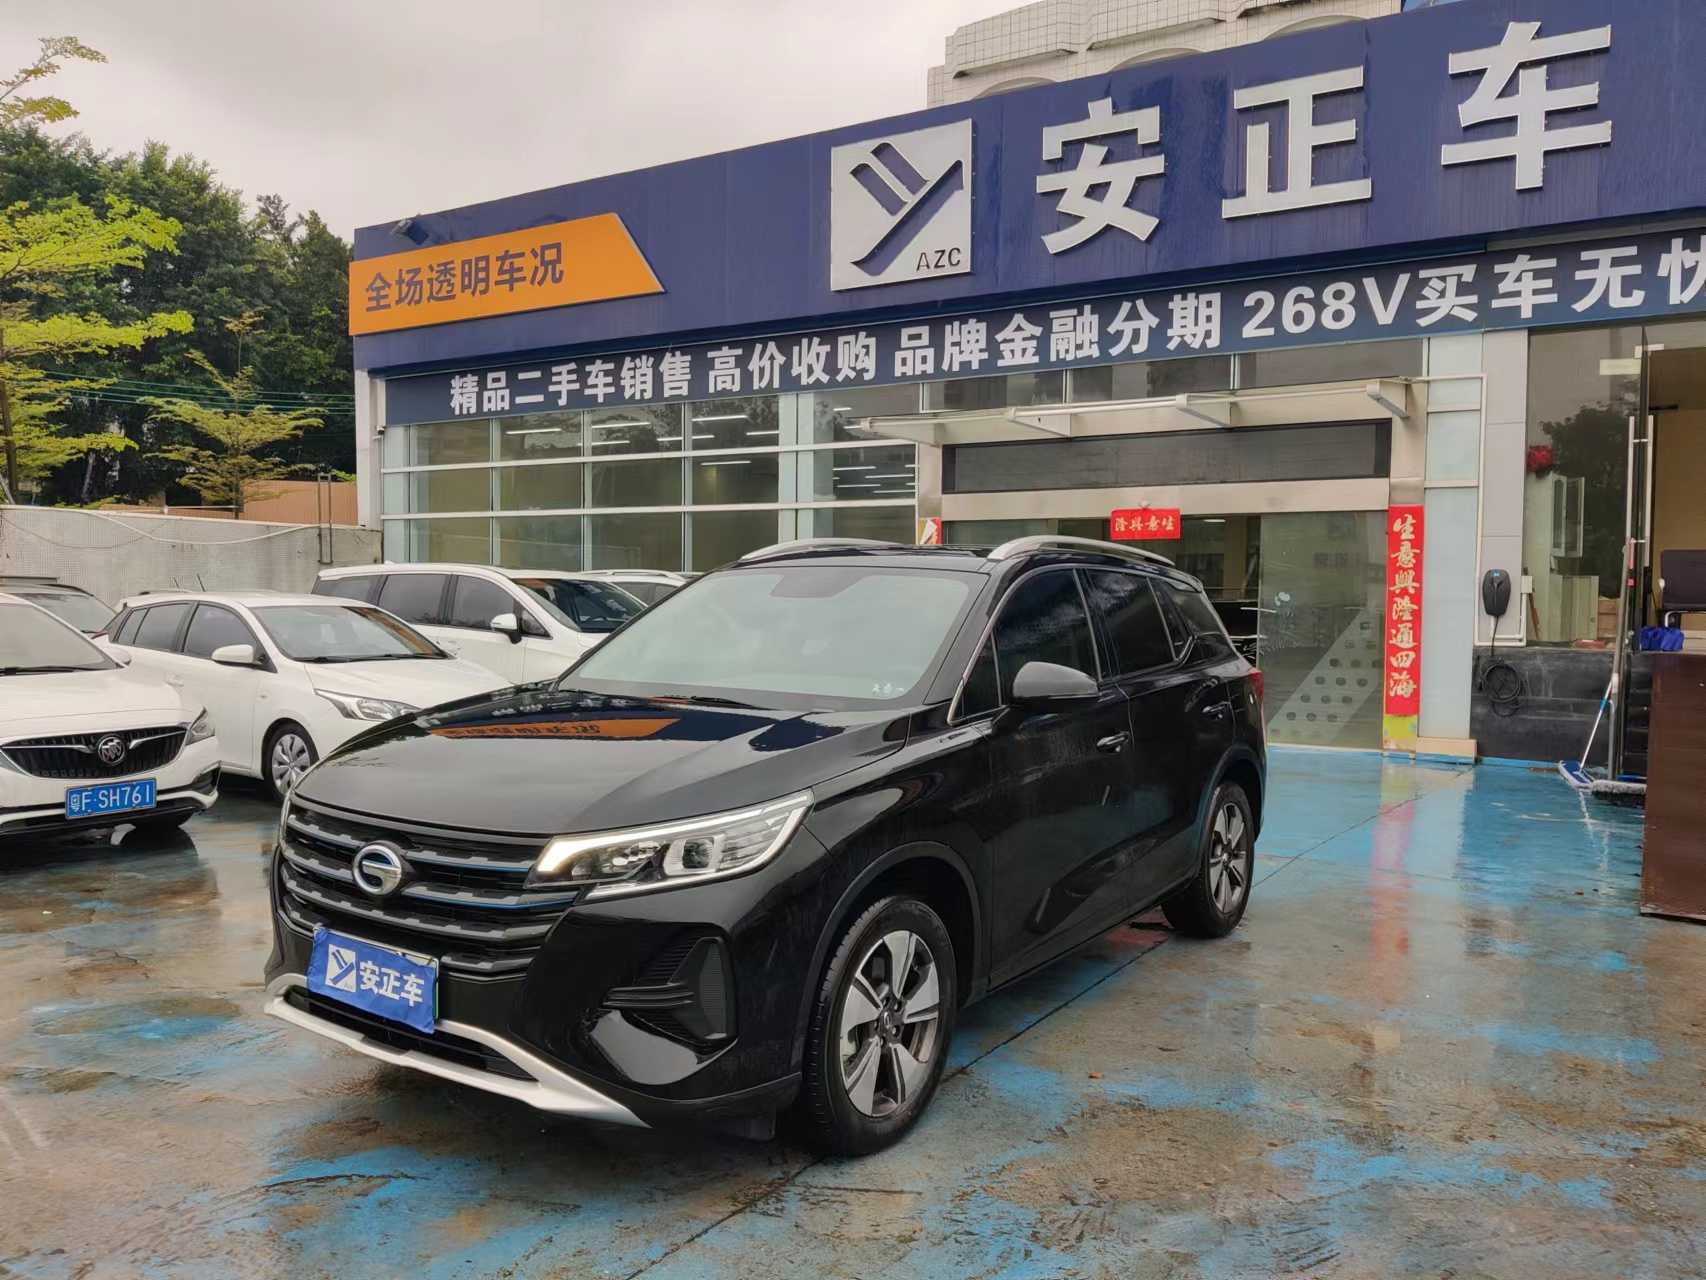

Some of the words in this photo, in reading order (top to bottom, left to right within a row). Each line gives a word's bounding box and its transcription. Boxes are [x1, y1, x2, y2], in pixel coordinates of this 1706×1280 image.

[1036, 21, 1612, 254] 安正车
[365, 242, 564, 312] 全场透明车况
[916, 247, 961, 271] AZC
[449, 351, 692, 415] 精品二手车销售
[707, 331, 877, 393] 高价收购
[894, 292, 1222, 376] 品牌金融分期
[359, 960, 425, 1007] 安正车
